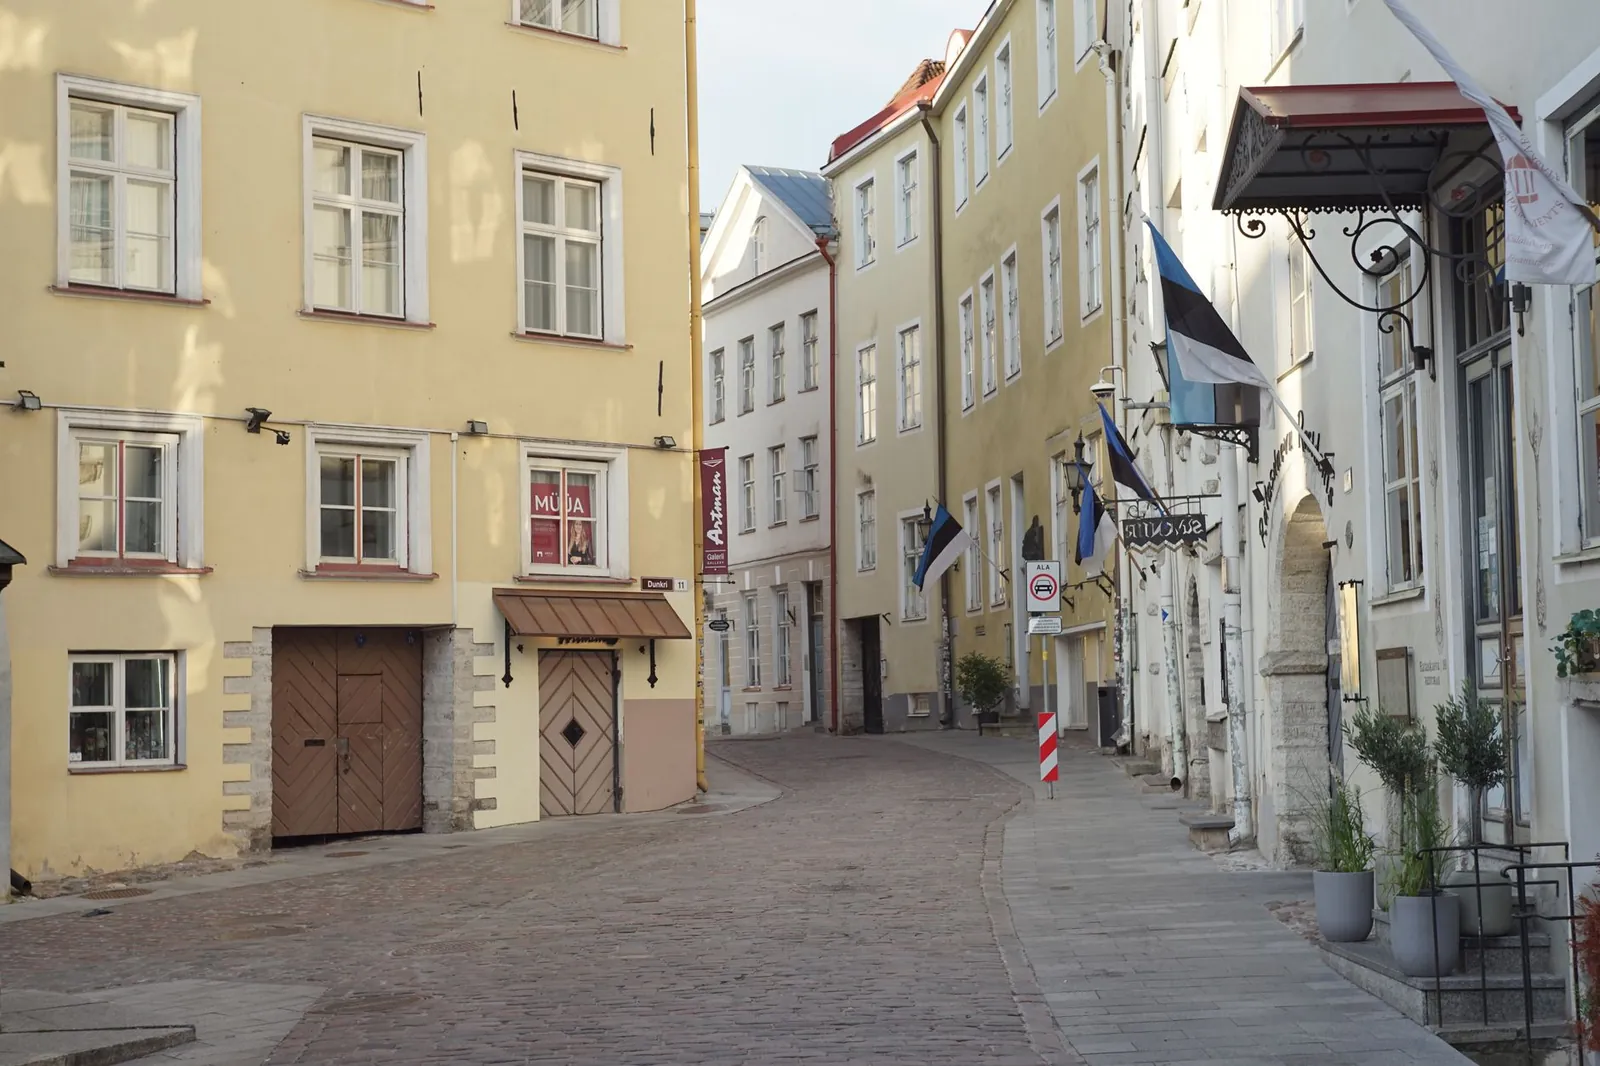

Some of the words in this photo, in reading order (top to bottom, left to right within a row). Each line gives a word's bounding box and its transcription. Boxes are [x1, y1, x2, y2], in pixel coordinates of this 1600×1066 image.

[707, 471, 724, 546] Artman
[707, 552, 724, 561] Galerii
[647, 580, 668, 588] Dunkri
[678, 581, 685, 589] 11
